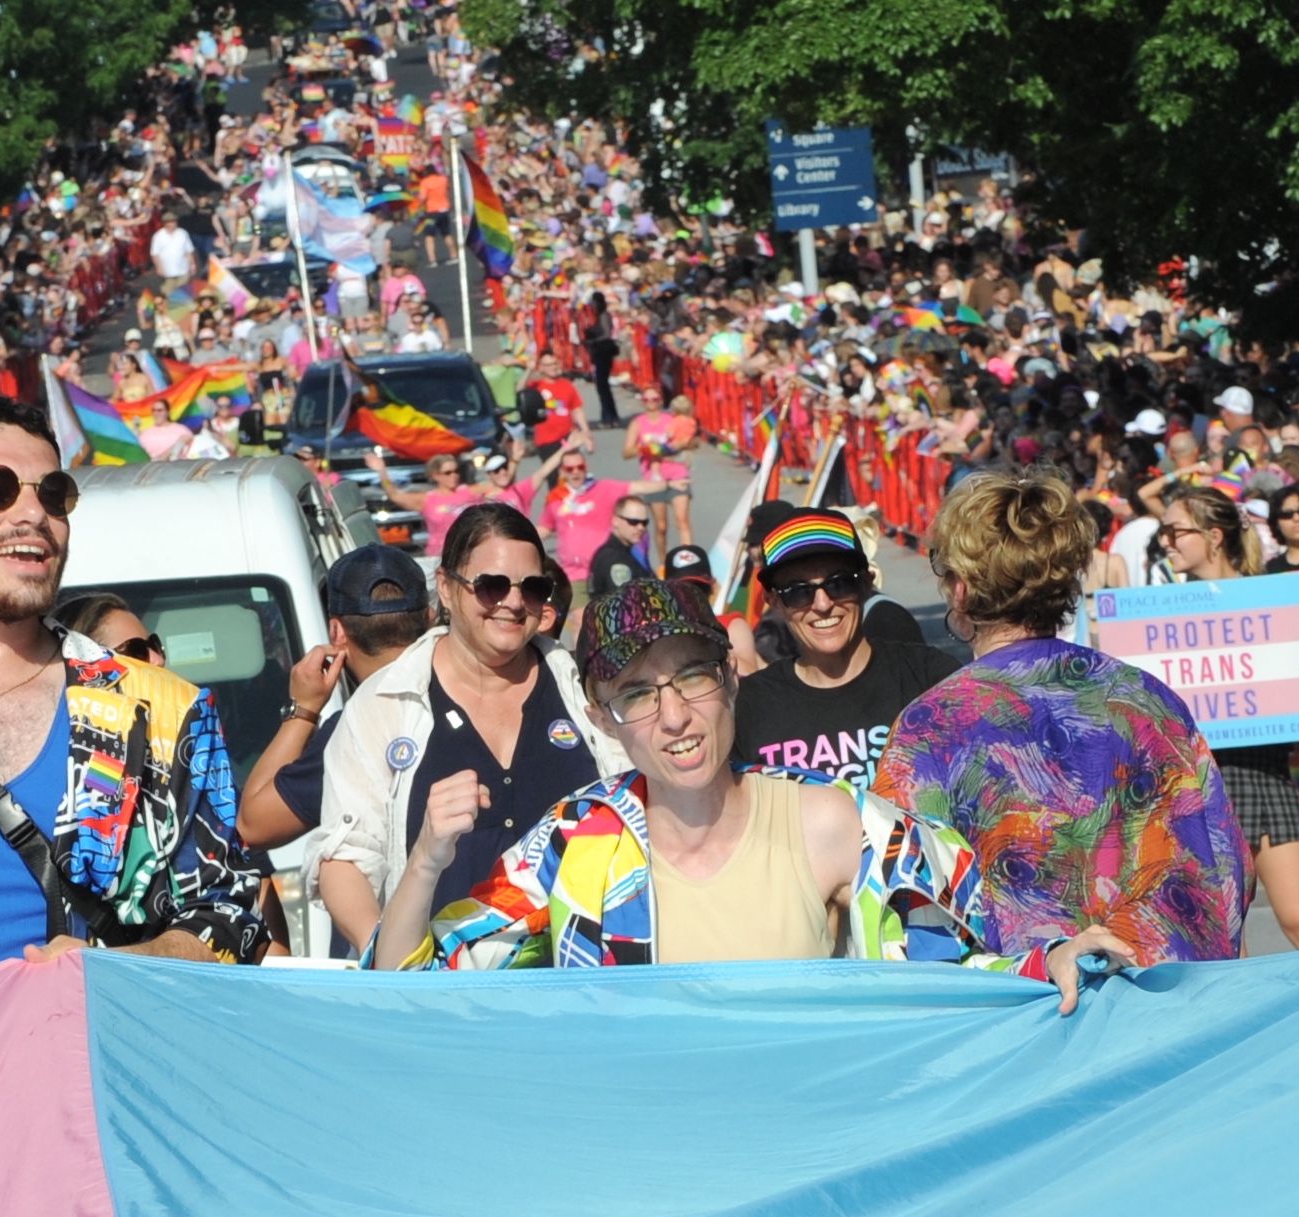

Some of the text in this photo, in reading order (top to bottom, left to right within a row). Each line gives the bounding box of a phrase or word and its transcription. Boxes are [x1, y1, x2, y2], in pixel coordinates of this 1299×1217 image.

[792, 132, 835, 148] Square
[794, 156, 840, 171] Visitors
[795, 170, 836, 184] Center
[777, 202, 820, 218] Library
[1146, 614, 1272, 651] PROTECT
[1160, 652, 1255, 686] TRANS
[1193, 689, 1258, 720] IVES
[759, 725, 890, 770] TRANS
